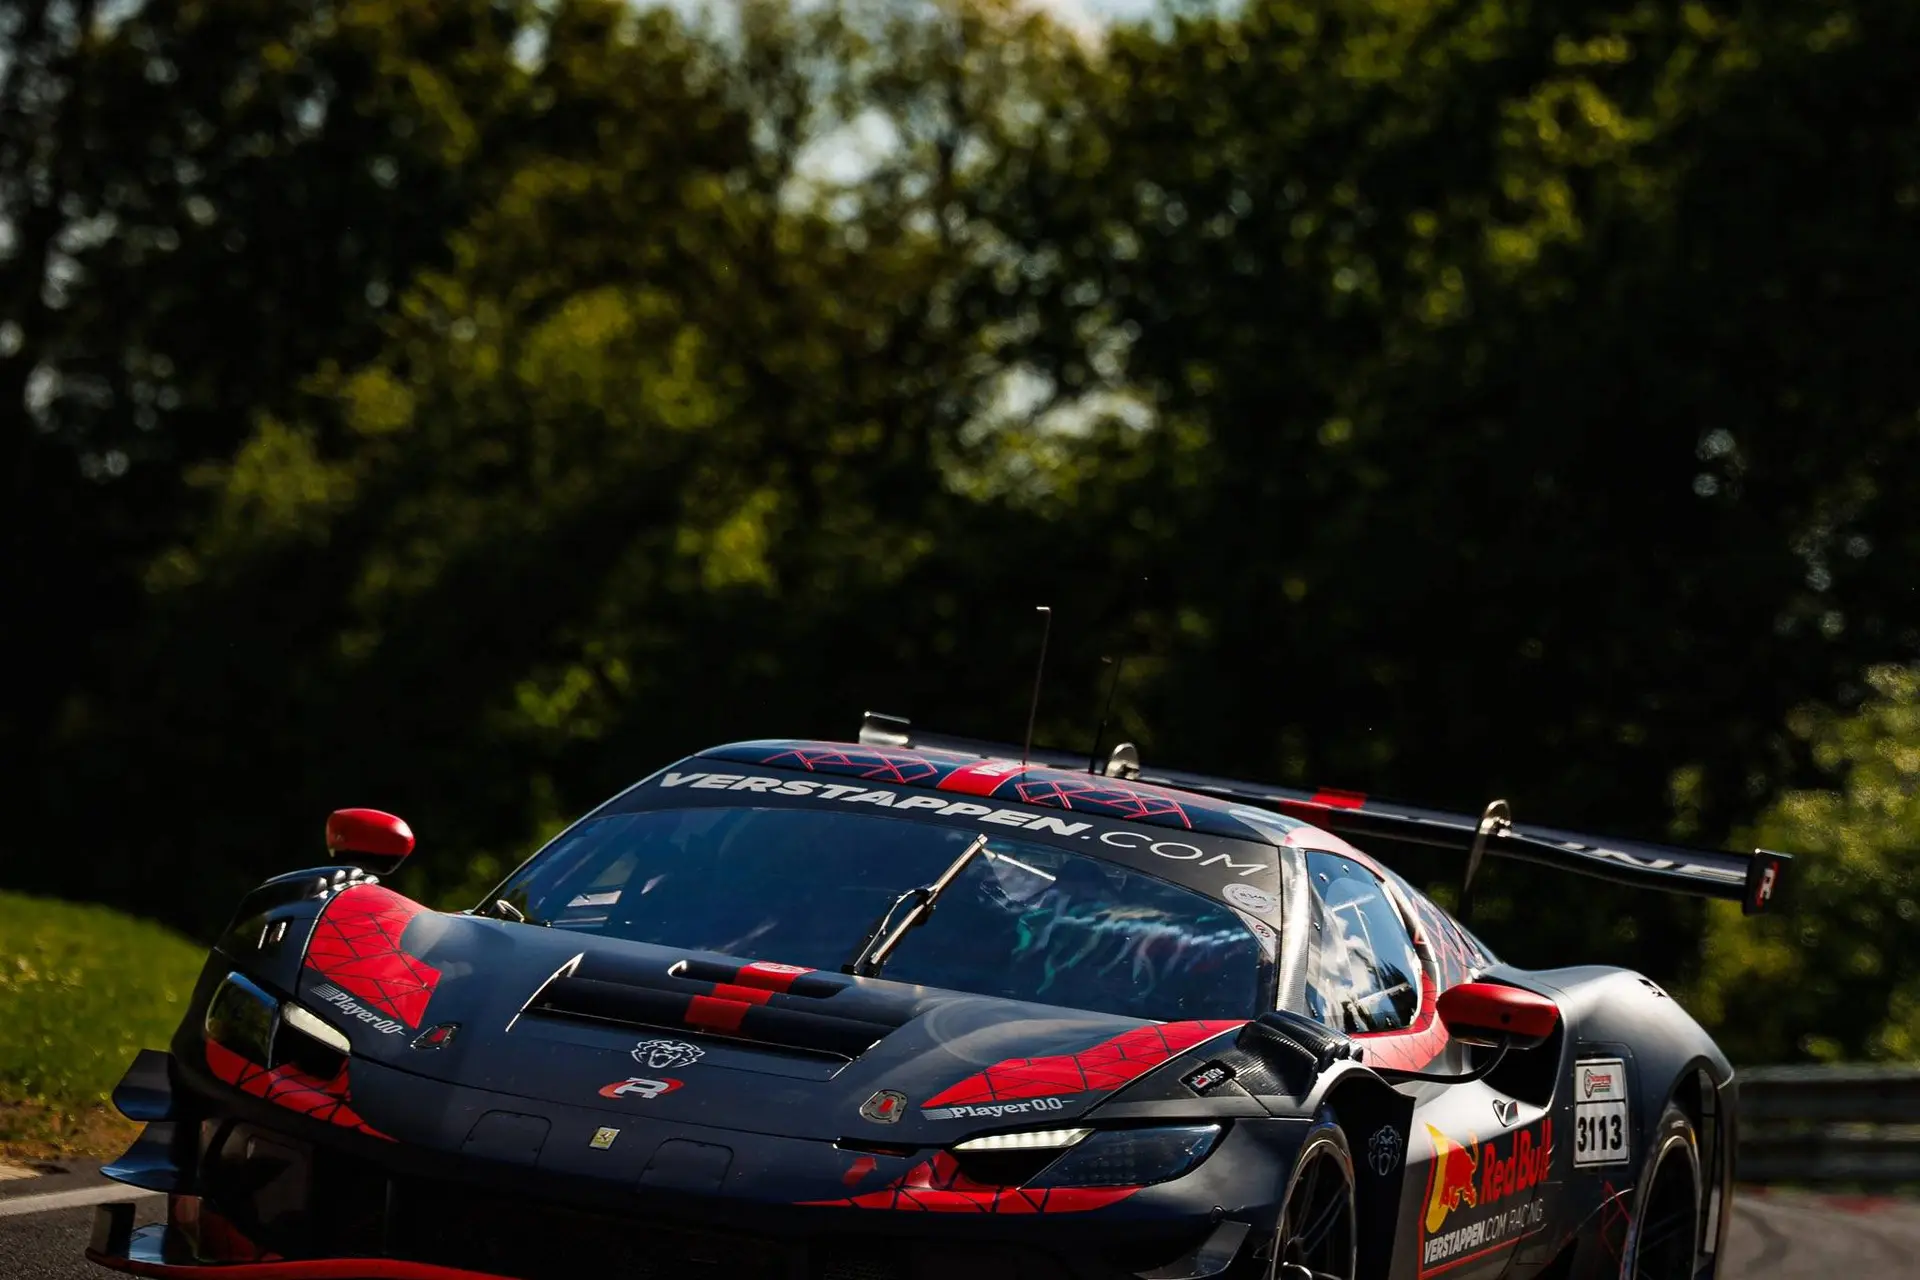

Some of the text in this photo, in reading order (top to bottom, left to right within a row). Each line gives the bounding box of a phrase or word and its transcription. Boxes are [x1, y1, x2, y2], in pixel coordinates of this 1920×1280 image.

[658, 772, 1268, 876] VERSTAPPEN.COM
[950, 1103, 1031, 1118] Player
[1577, 1114, 1622, 1152] 3113
